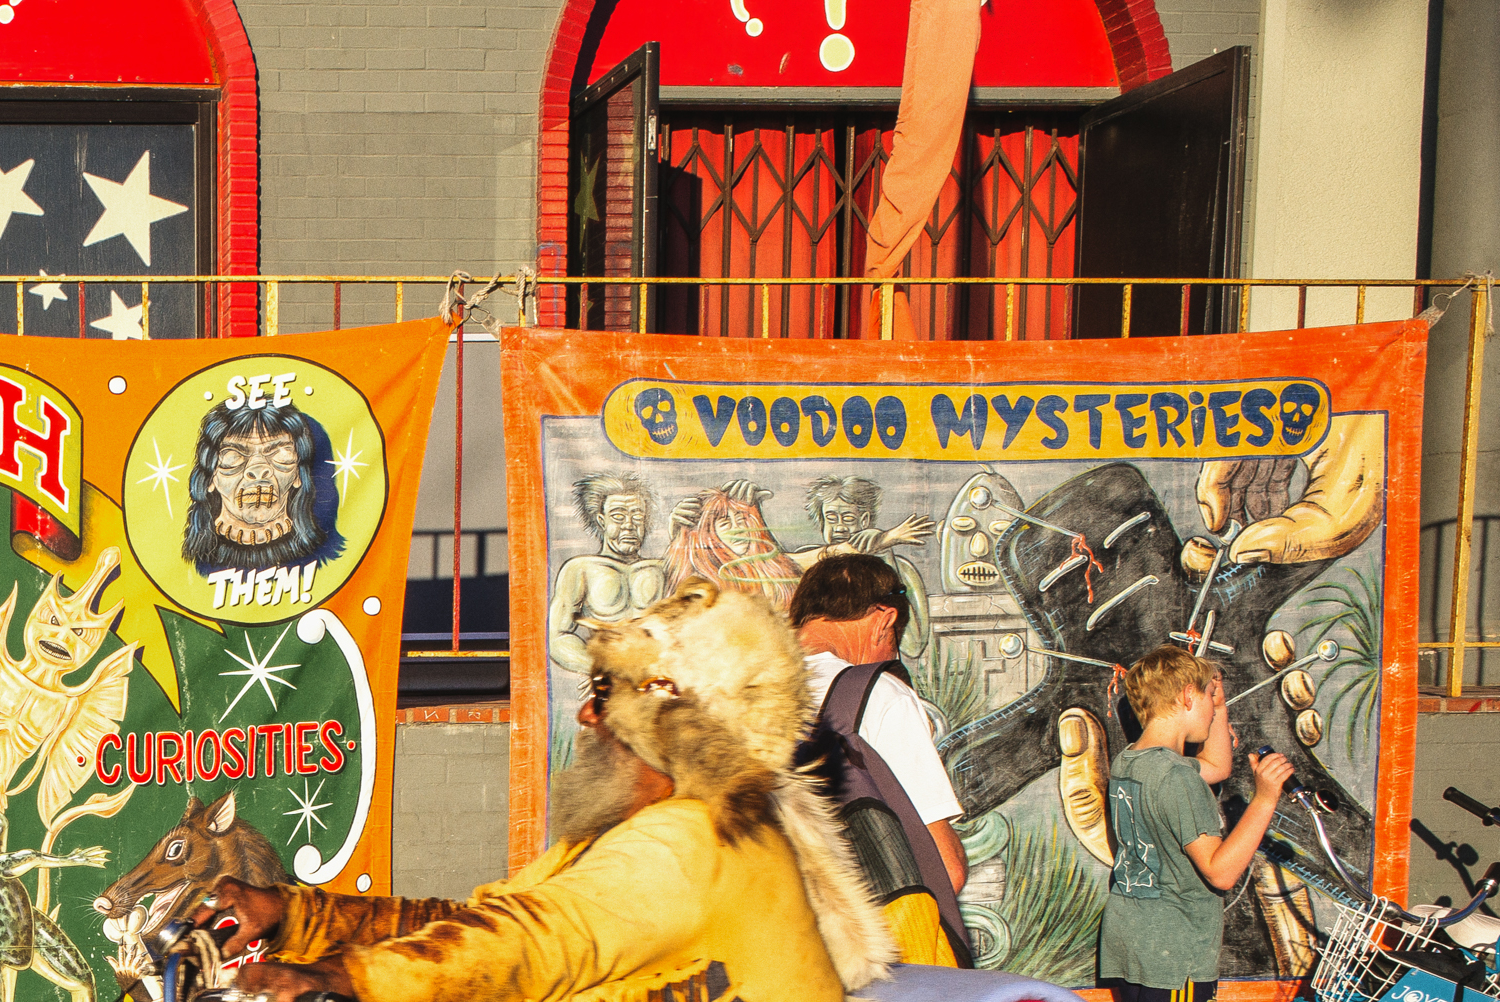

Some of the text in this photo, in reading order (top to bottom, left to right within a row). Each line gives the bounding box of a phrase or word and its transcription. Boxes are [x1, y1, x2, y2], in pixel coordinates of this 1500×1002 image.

[225, 371, 294, 411] SEE
[693, 393, 908, 450] VOODOO
[206, 562, 318, 608] THEM!
[95, 720, 347, 786] CURIOSITIES
